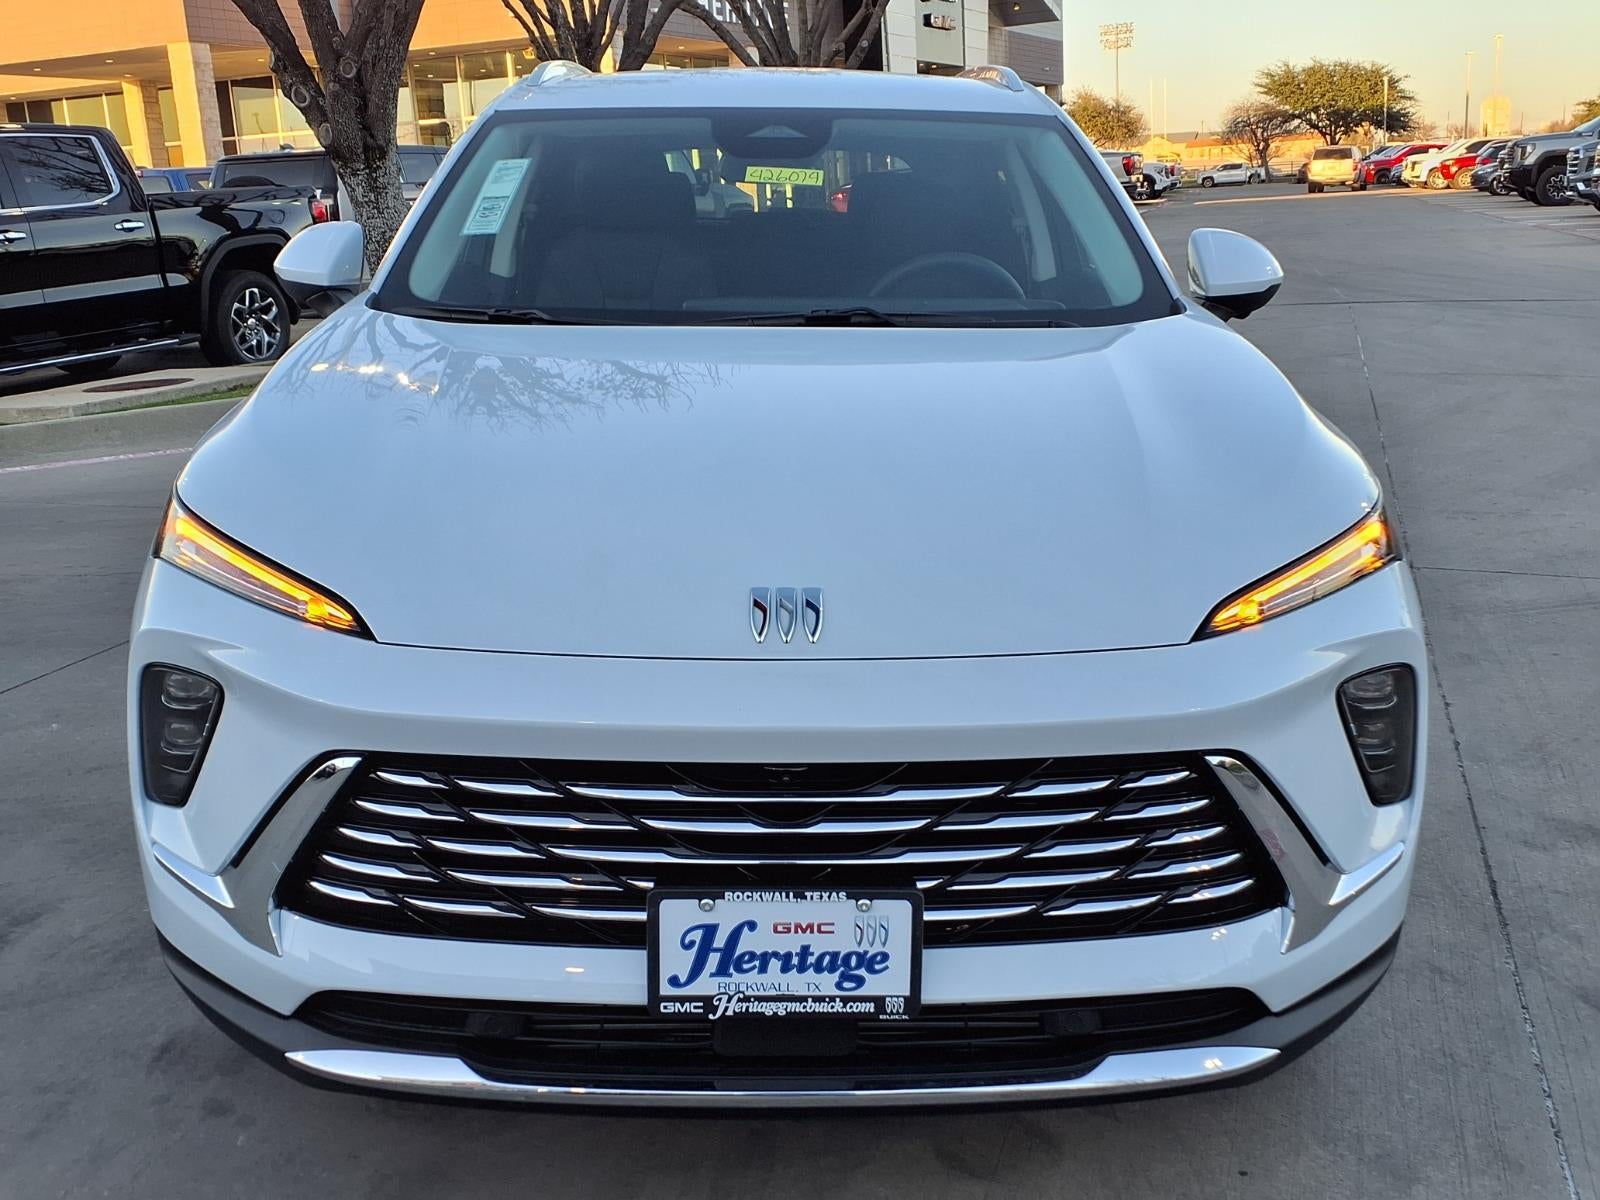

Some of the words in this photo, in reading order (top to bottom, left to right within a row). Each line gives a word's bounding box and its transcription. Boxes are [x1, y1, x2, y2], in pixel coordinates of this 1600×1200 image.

[724, 891, 800, 903] ROCKWALL,
[805, 891, 847, 902] TEXAS
[773, 922, 835, 935] GMC
[667, 920, 890, 992] Heritage
[805, 983, 822, 992] TX
[660, 1002, 704, 1013] GMC
[708, 993, 875, 1019] Heritagegmcbuick.com
